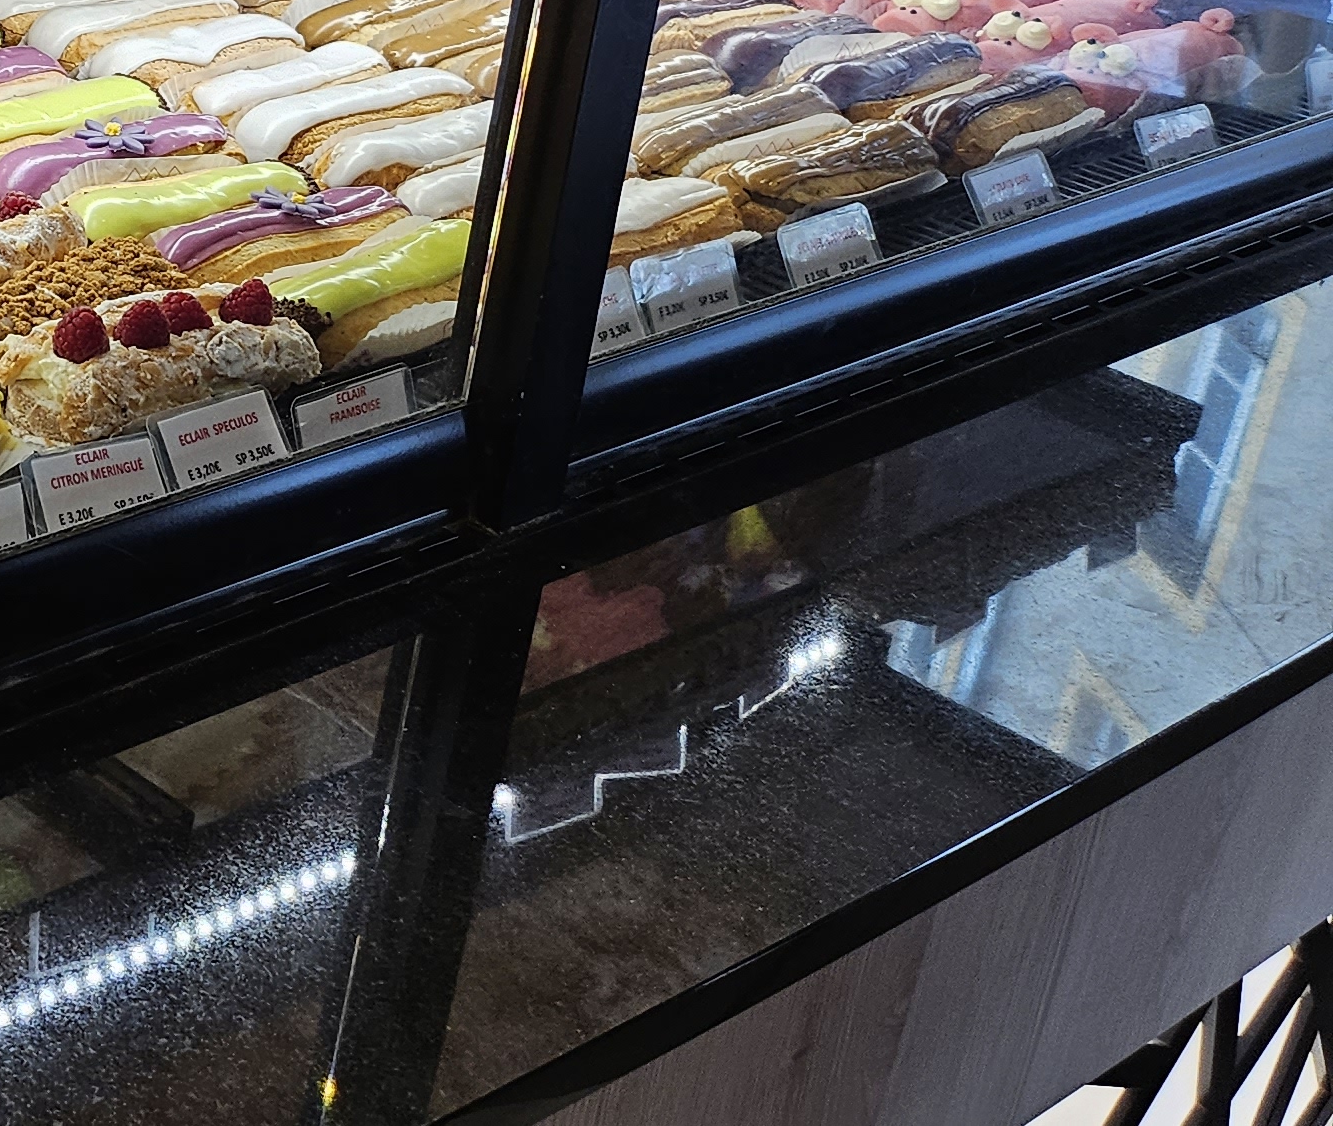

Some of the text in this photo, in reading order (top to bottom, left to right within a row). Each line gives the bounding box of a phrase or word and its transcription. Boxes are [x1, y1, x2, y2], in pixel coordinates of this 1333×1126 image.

[597, 330, 609, 343] SP
[335, 386, 367, 406] ECLAIR
[329, 397, 382, 425] FRAMBOISE
[178, 411, 260, 448] ECLAIR SPECULOS
[74, 447, 110, 466] ECLAIR
[187, 443, 276, 481] E 3,20€ SP 3,50€
[50, 468, 90, 491] CITRON
[59, 506, 96, 526] E 3,20€
